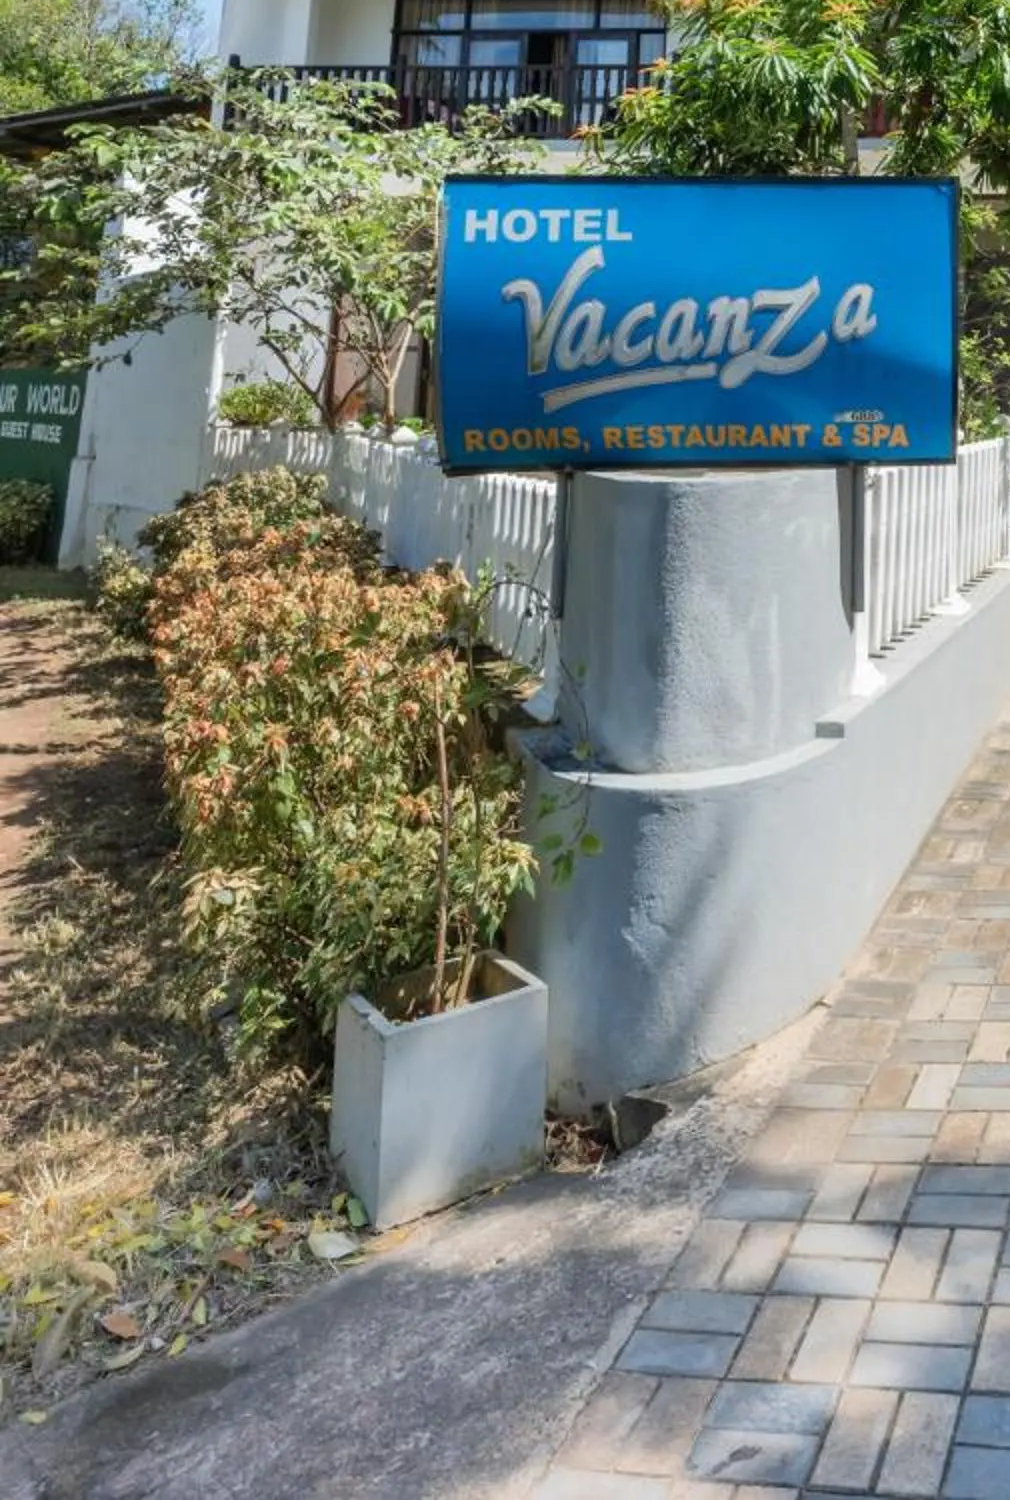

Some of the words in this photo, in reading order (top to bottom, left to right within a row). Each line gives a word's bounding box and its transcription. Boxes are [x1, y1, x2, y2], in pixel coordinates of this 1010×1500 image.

[464, 208, 633, 242] HOTEL
[26, 383, 80, 415] WORLD
[464, 427, 590, 453] ROOMS,
[603, 424, 811, 449] RESTAURANT
[823, 424, 842, 447] &
[852, 424, 909, 448] SPA
